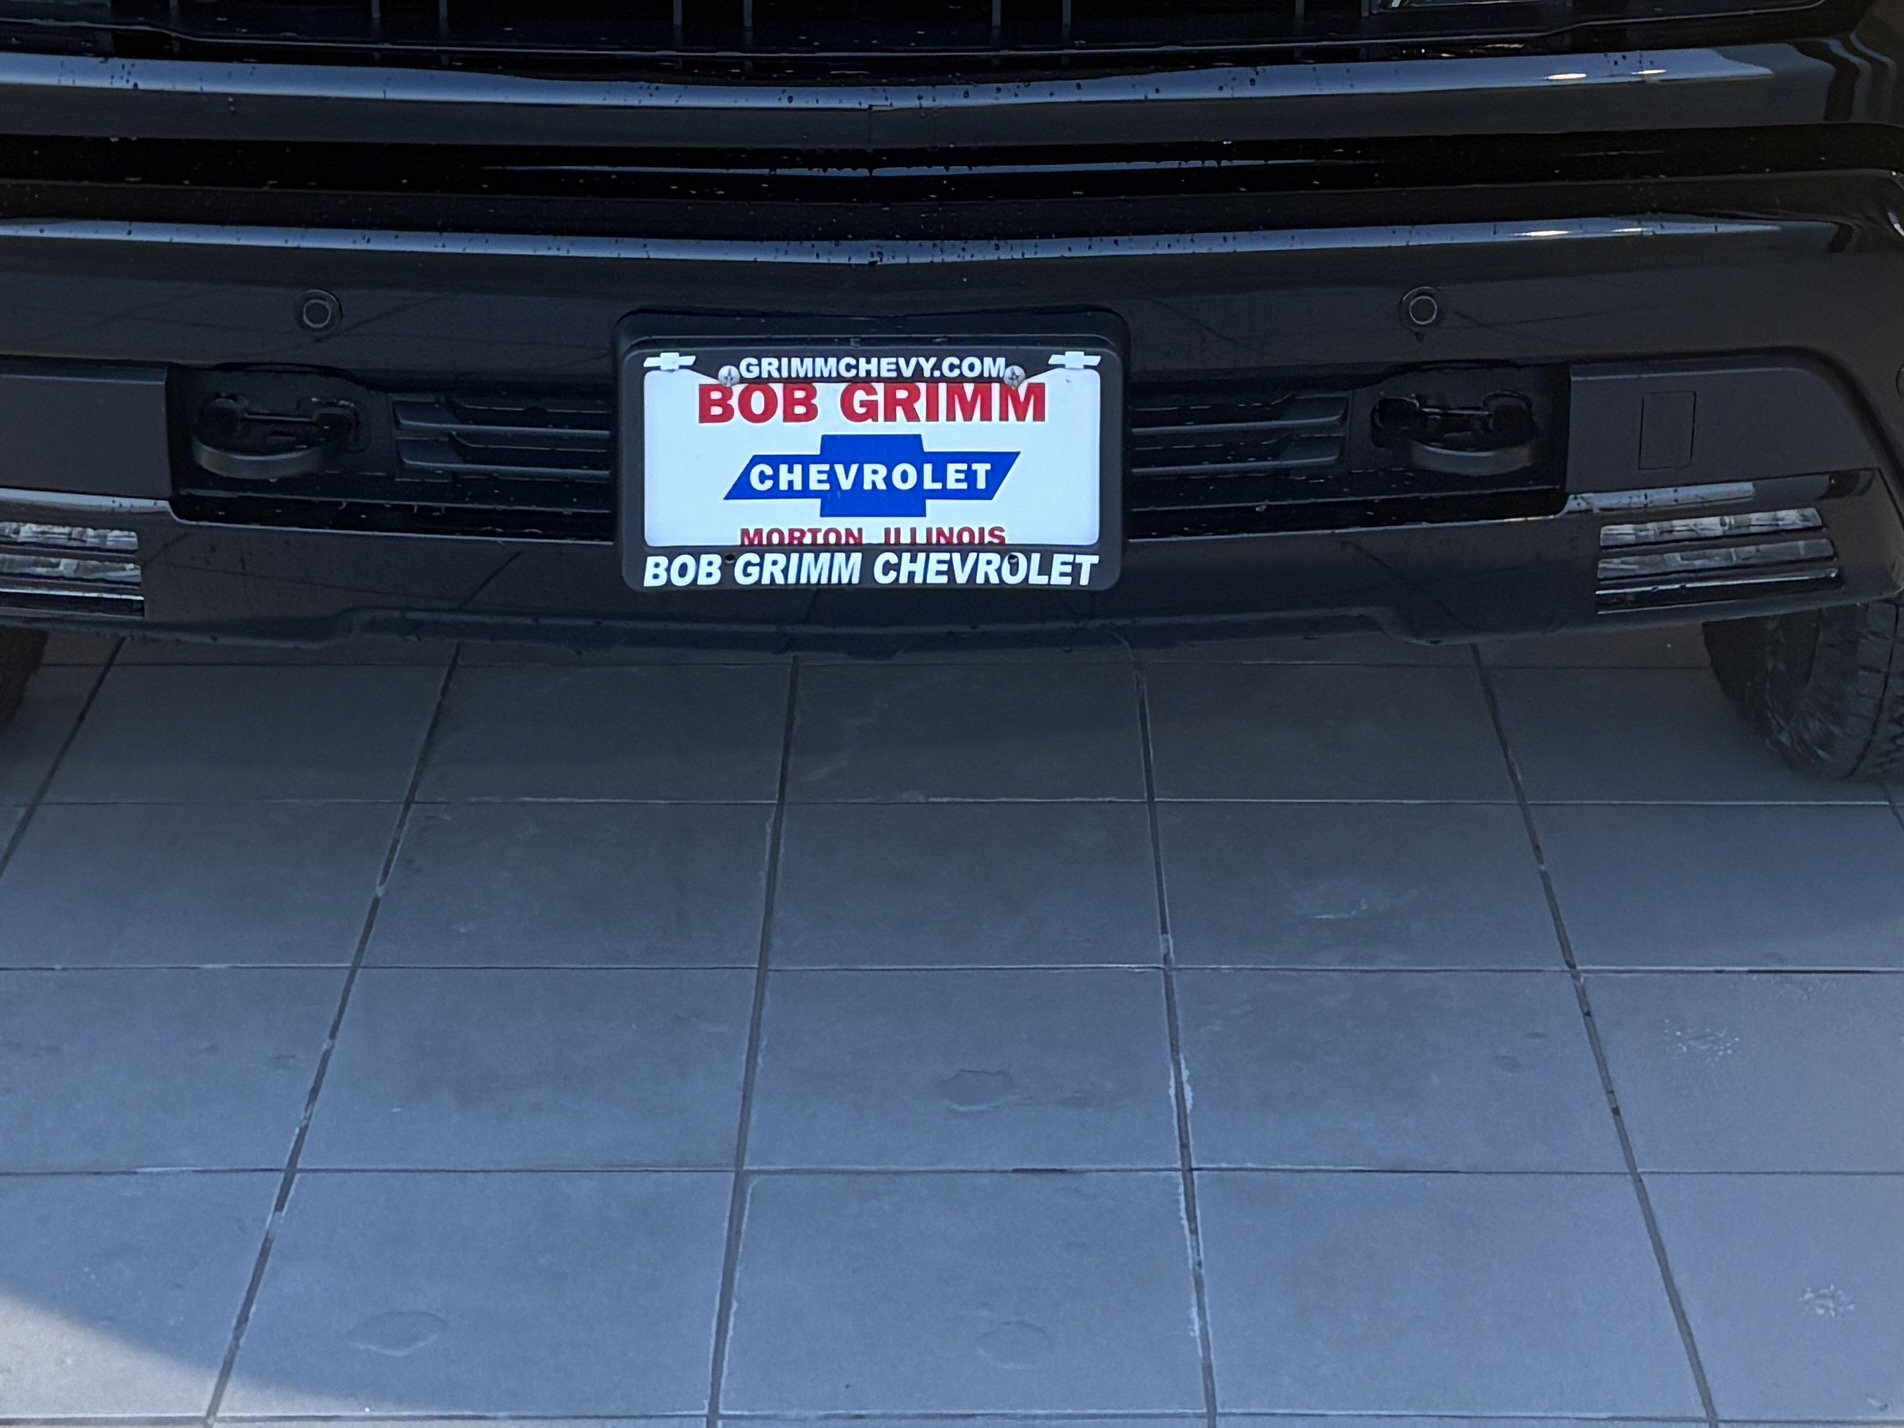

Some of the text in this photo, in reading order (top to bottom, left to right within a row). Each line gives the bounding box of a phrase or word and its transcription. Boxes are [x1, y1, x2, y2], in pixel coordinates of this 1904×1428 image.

[739, 356, 1006, 379] GRIMMCHEVY.COM
[698, 382, 1047, 424] BOB GRIMM
[748, 462, 993, 491] CHEVROLET
[739, 525, 1007, 546] MORTON ILLINOIS
[643, 552, 1099, 587] BOB GRIMM CHEVROLET
